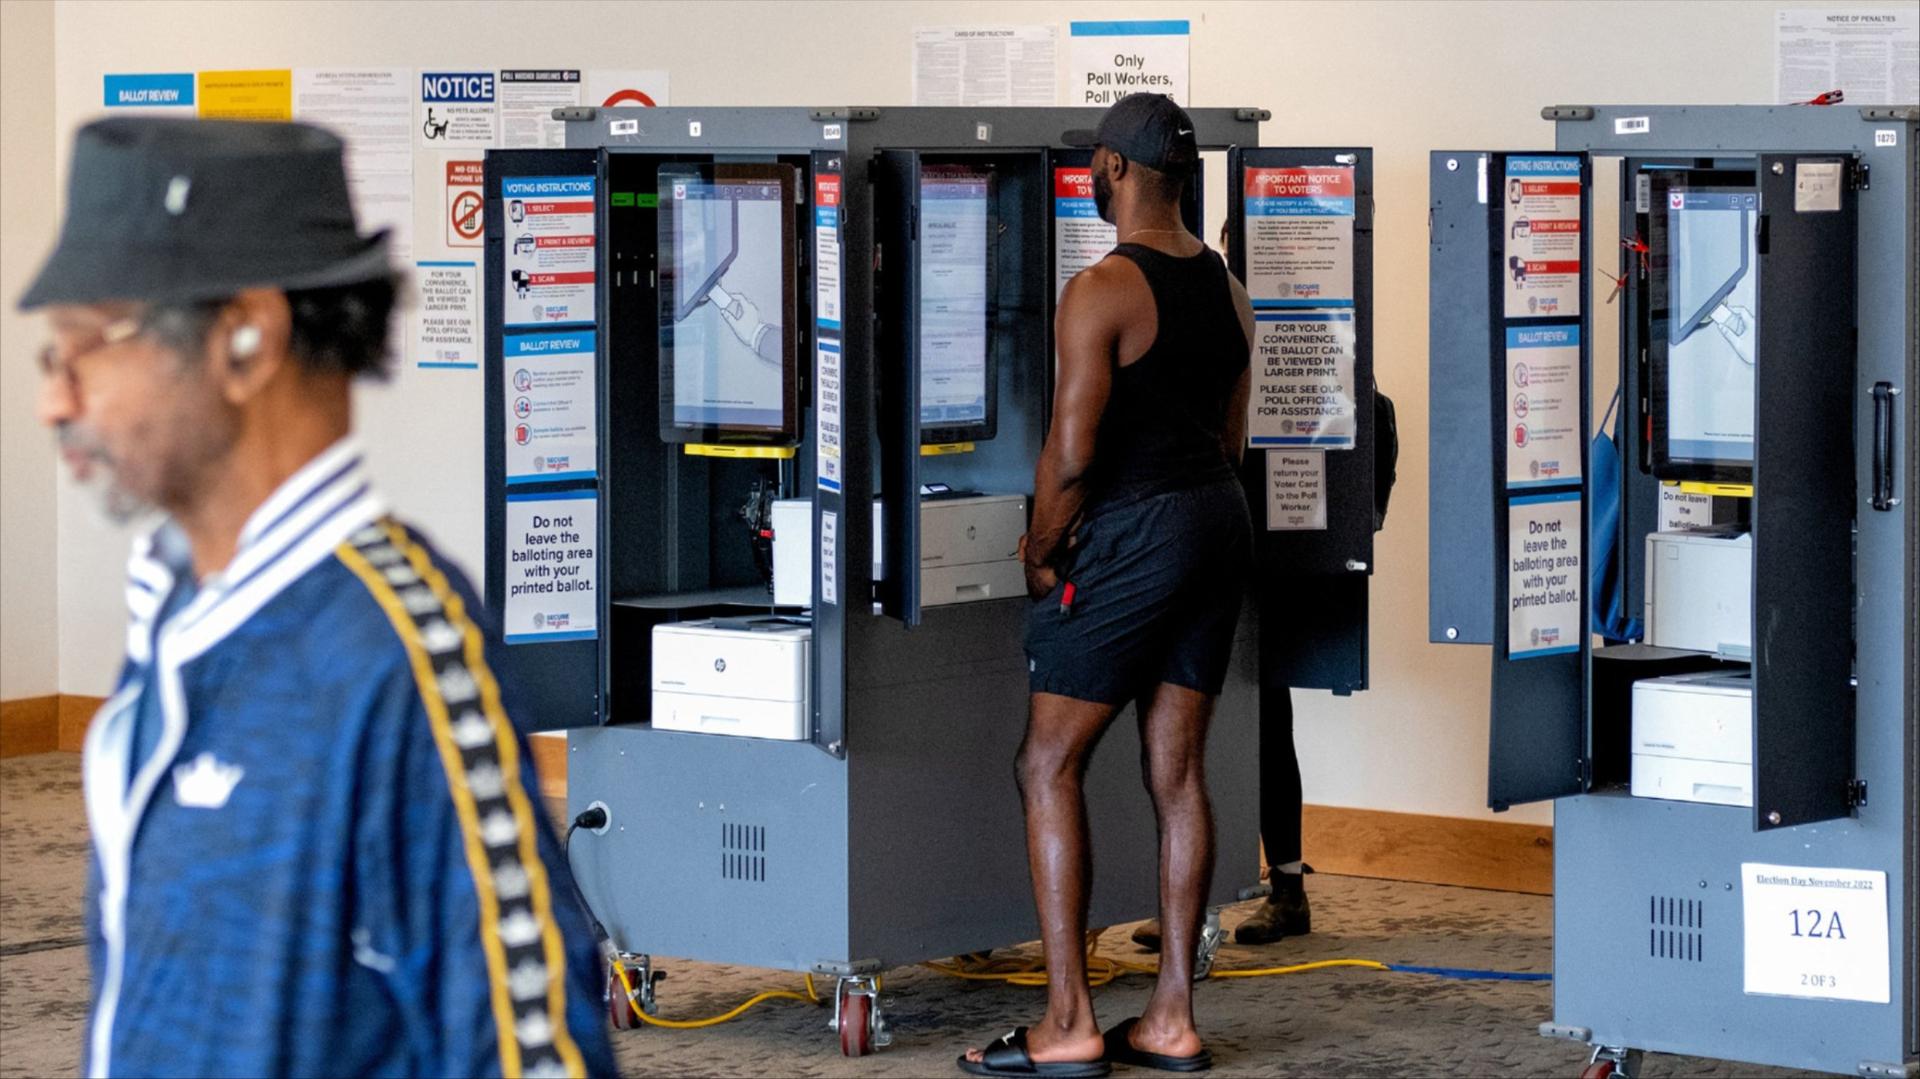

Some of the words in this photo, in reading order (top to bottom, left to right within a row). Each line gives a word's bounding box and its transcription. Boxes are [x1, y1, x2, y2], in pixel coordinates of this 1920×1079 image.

[1114, 54, 1144, 70] Only
[1087, 72, 1111, 85] Poll
[1115, 72, 1172, 86] Workers,
[424, 77, 493, 98] NOTICE
[119, 90, 148, 102] BALLOT
[149, 90, 179, 101] REVIEW
[1086, 90, 1109, 103] Poll
[1509, 160, 1532, 171] VOTING
[1532, 160, 1578, 171] INSTRUCTIONS
[1062, 174, 1093, 184] IMPORTA
[1255, 175, 1307, 184] IMPORTANT
[1308, 175, 1341, 184] NOTICE
[507, 184, 535, 192] VOTING
[536, 182, 591, 192] INSTRUCTIONS
[1077, 186, 1085, 195] TO
[1274, 186, 1285, 194] TO
[1288, 185, 1322, 194] VOTERS
[1532, 263, 1546, 271] SCAN
[1275, 324, 1296, 332] FOR
[1298, 324, 1327, 332] YOUR
[1263, 335, 1338, 344] CONVENIENCE,
[1518, 333, 1542, 343] BALLOT
[1543, 331, 1568, 342] REVIEW
[520, 341, 549, 351] BALLOT
[550, 340, 580, 350] REVIEW
[1259, 346, 1278, 354] THE
[1281, 346, 1318, 354] BALLOT
[1322, 346, 1343, 354] CAN
[1264, 368, 1304, 376] LARGER
[1306, 368, 1338, 376] PRINT.
[1300, 385, 1318, 393] SEE
[1320, 385, 1342, 393] OUR
[1265, 396, 1290, 404] POLL
[1292, 396, 1338, 404] OFFICIAL
[1258, 408, 1278, 416] FOR
[1281, 408, 1344, 416] ASSISTANCE.
[1300, 470, 1318, 478] your
[1664, 492, 1673, 500] Do
[1688, 495, 1707, 503] leave
[533, 516, 550, 528] Do
[553, 516, 573, 527] not
[1529, 521, 1542, 534] Do
[1545, 520, 1561, 532] not
[526, 533, 557, 545] leave
[560, 532, 580, 543] the
[1524, 540, 1548, 553] leave
[1551, 537, 1566, 550] the
[512, 550, 564, 563] balloting
[567, 549, 593, 559] area
[1513, 557, 1553, 572] balloting
[1556, 556, 1578, 567] area
[524, 565, 550, 577] with
[553, 565, 580, 579] your
[1523, 576, 1543, 588] with
[1546, 574, 1567, 590] your
[511, 581, 553, 597] printed
[557, 580, 593, 592] ballot.
[1512, 592, 1546, 611] printed
[1549, 590, 1578, 604] ballot.
[1757, 875, 1789, 884] Election
[1791, 877, 1806, 886] Day
[1809, 878, 1851, 888] November
[1853, 880, 1873, 889] 2022
[1788, 909, 1847, 939] 12A
[1801, 974, 1808, 985] 2
[1811, 975, 1826, 986] OF
[1829, 976, 1836, 987] 3
